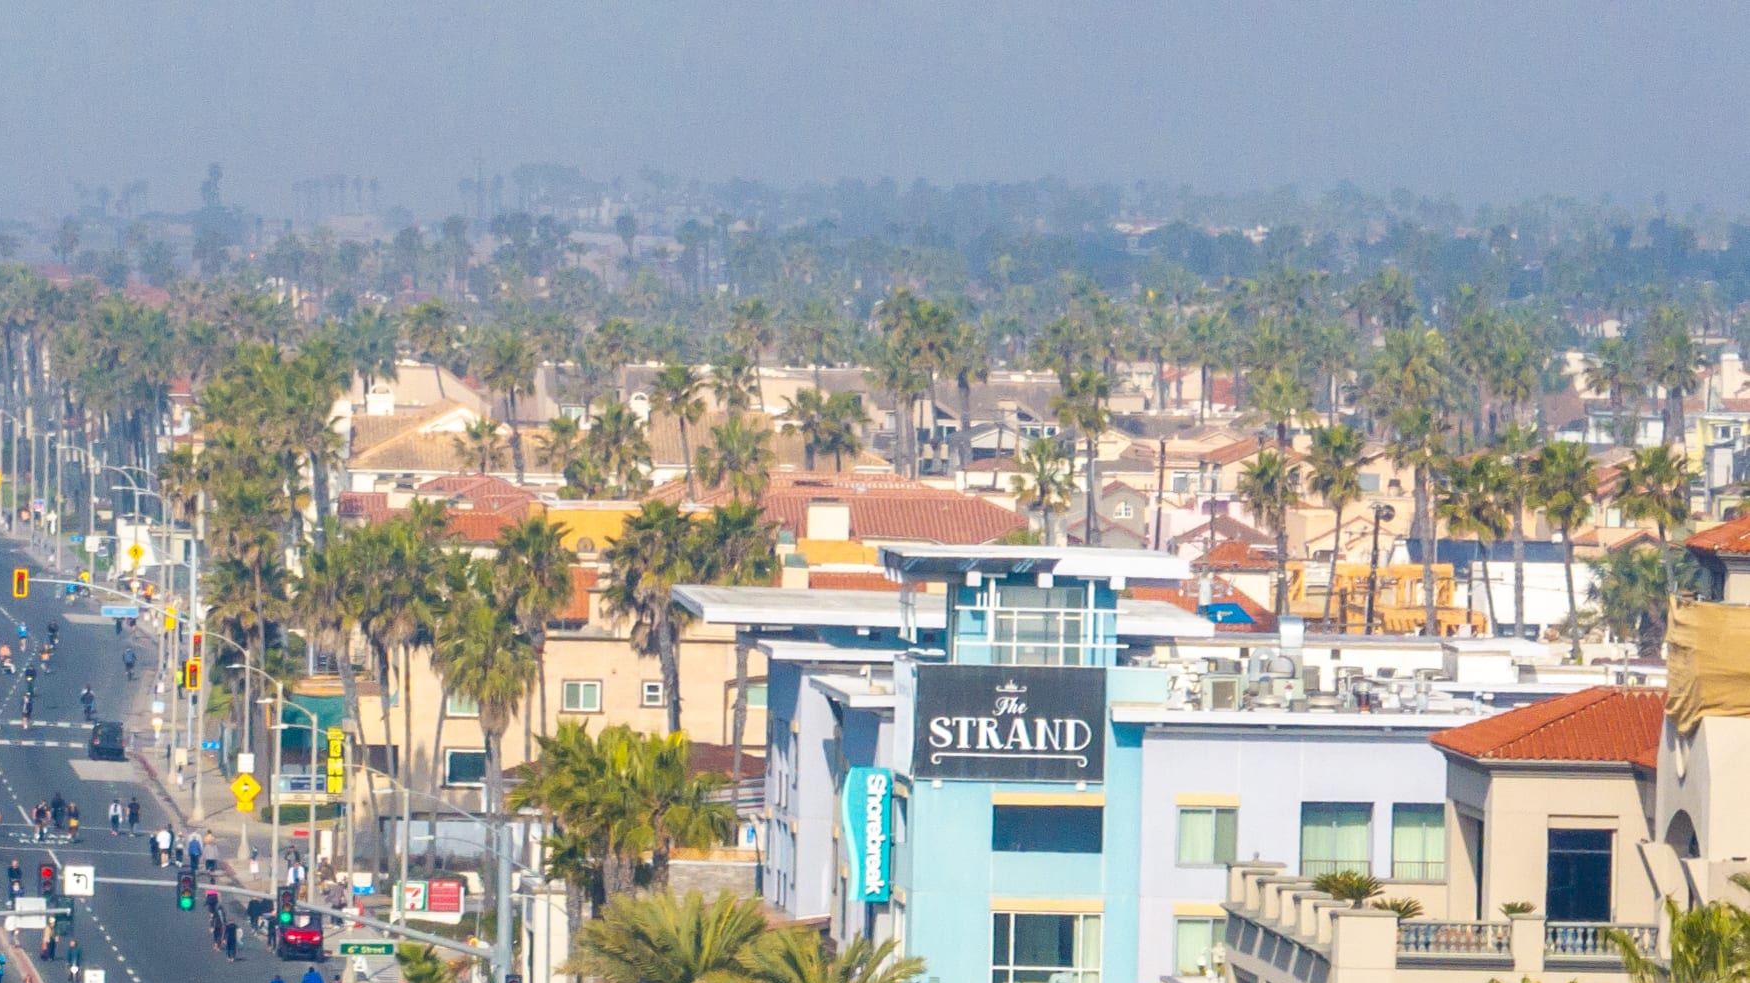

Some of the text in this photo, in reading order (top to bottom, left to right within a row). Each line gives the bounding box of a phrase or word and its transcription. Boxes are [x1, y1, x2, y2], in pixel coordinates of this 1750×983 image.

[992, 696, 1028, 716] The
[928, 716, 1092, 751] STRAND
[865, 773, 887, 895] Shorebreak
